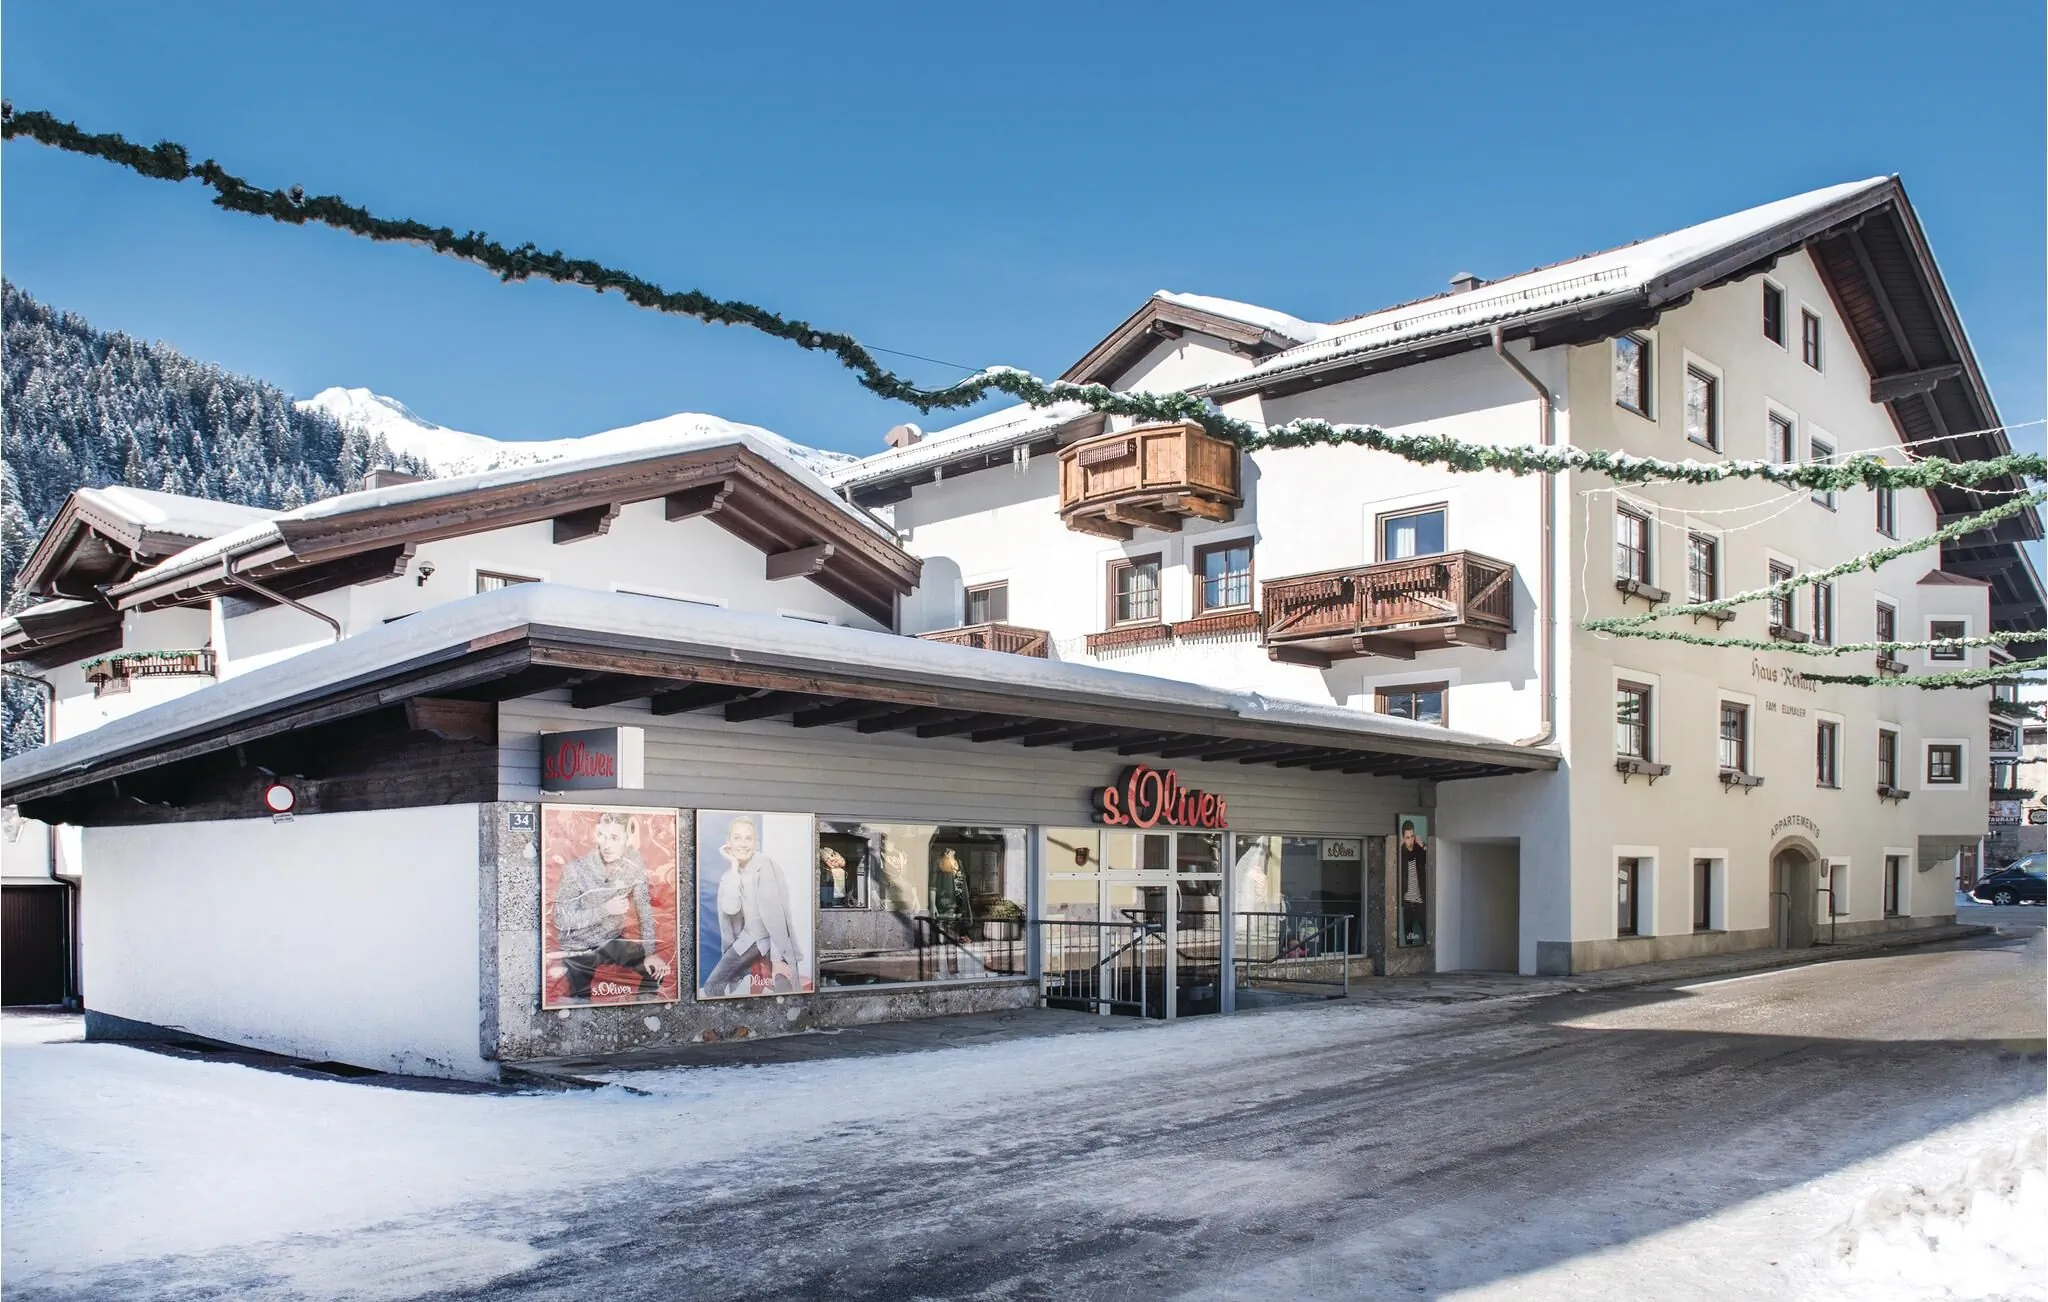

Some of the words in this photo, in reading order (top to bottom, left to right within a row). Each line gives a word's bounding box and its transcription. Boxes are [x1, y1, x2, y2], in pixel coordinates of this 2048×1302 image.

[1751, 657, 1778, 683] Haus
[546, 739, 614, 781] s.Oliver
[1103, 764, 1228, 829] s.Oliver
[513, 814, 529, 826] 34
[1770, 814, 1820, 839] APPARTEMENTS
[1327, 841, 1354, 858] s.Oliver
[591, 981, 632, 996] s.Oliver
